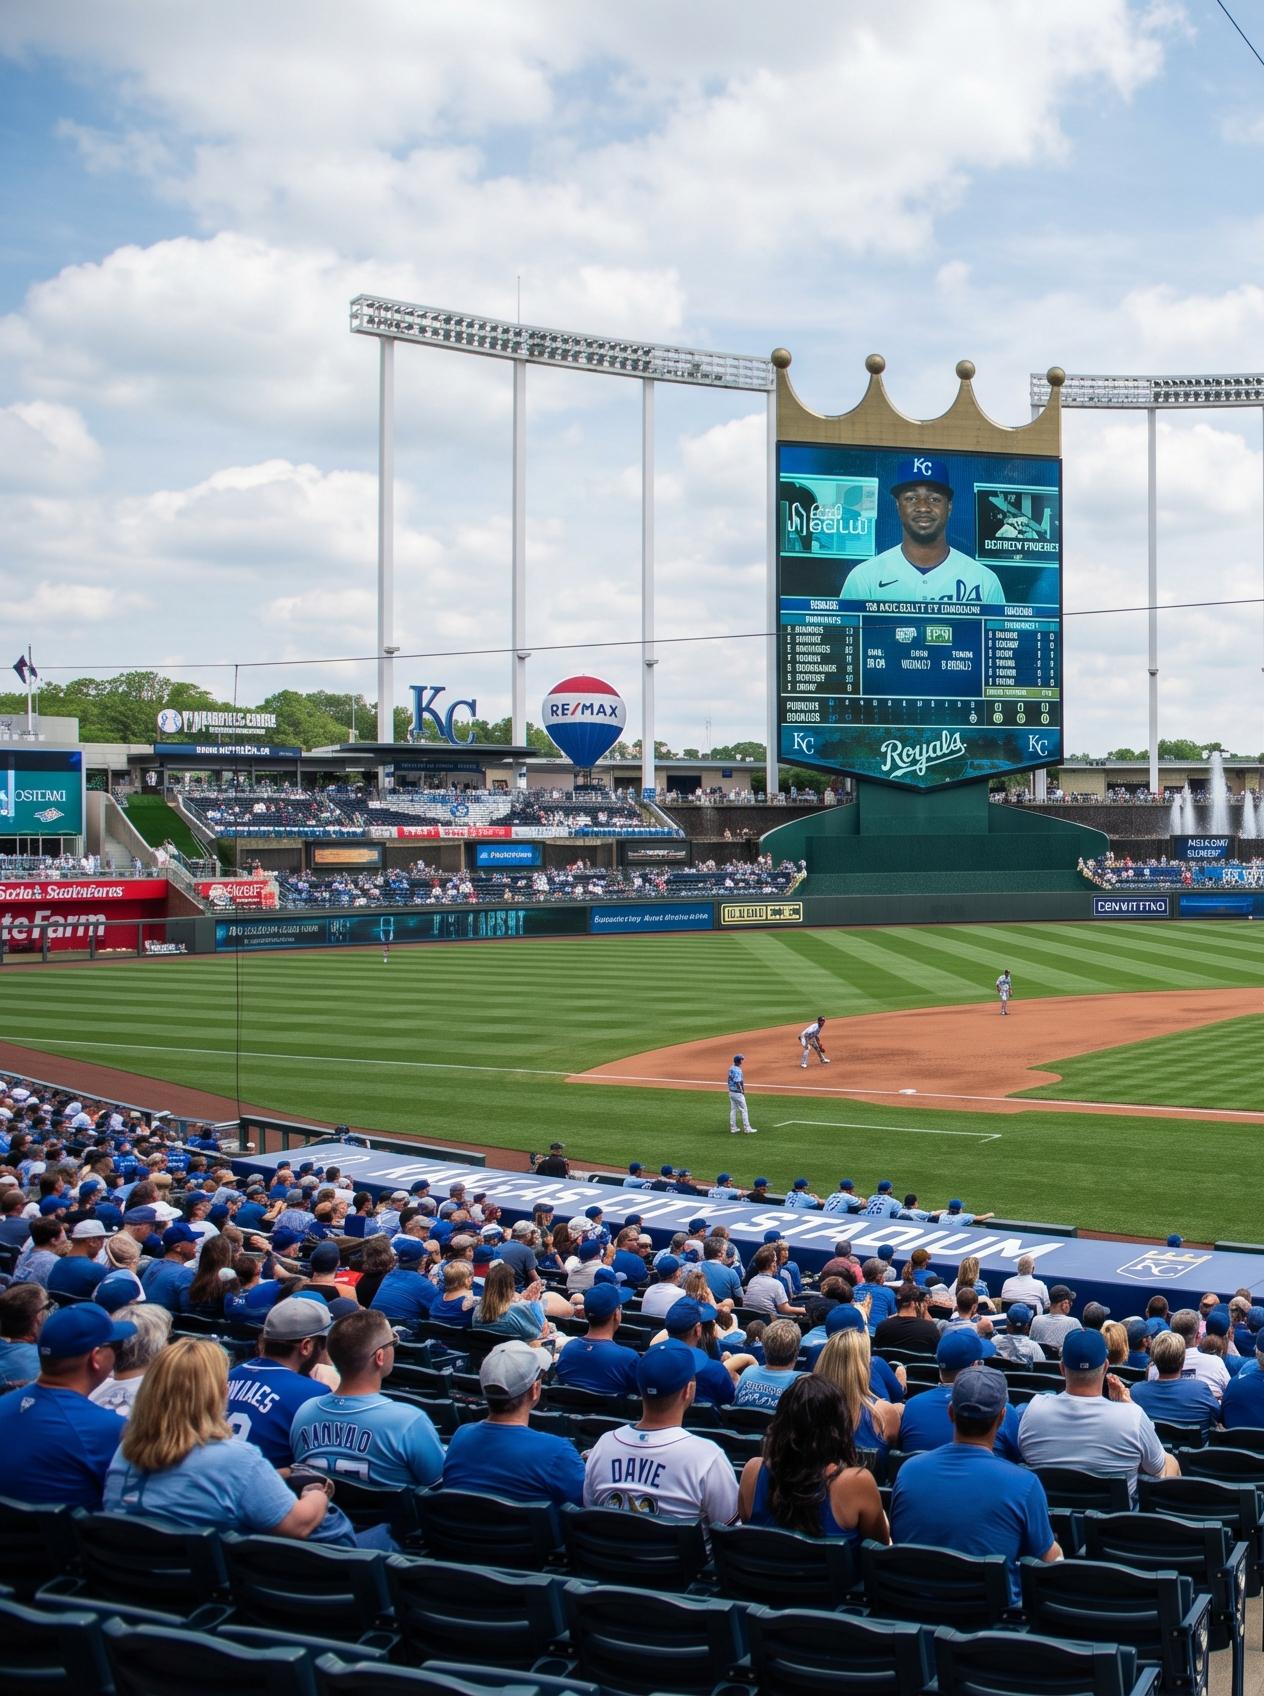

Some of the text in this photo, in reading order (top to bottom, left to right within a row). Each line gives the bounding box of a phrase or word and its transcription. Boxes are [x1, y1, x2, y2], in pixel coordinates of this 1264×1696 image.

[409, 685, 477, 744] KC
[550, 702, 618, 718] RE/MAX
[793, 732, 814, 755] KC
[1028, 734, 1048, 756] KC
[578, 1193, 760, 1224] CITY
[729, 1212, 1066, 1262] STADIUM
[1129, 1259, 1185, 1277] KC
